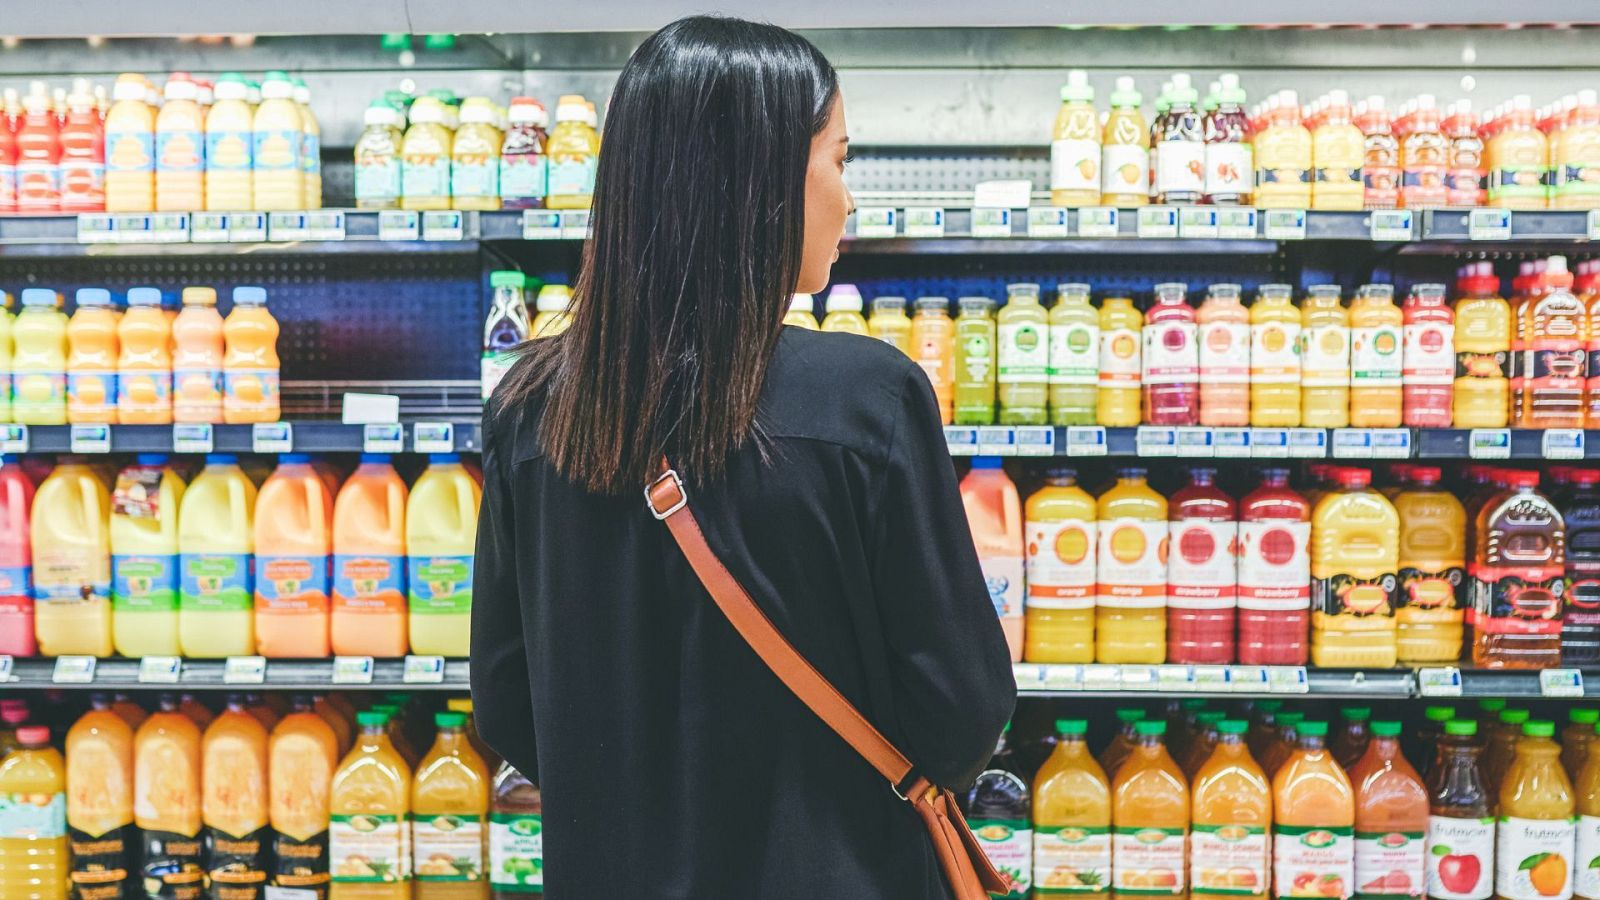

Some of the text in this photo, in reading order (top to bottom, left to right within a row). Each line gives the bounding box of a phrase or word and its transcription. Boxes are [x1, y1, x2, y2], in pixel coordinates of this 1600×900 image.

[1056, 588, 1086, 597] orange
[1112, 587, 1143, 597] orange
[1175, 587, 1220, 598] strawberry
[1254, 588, 1300, 599] strawberry
